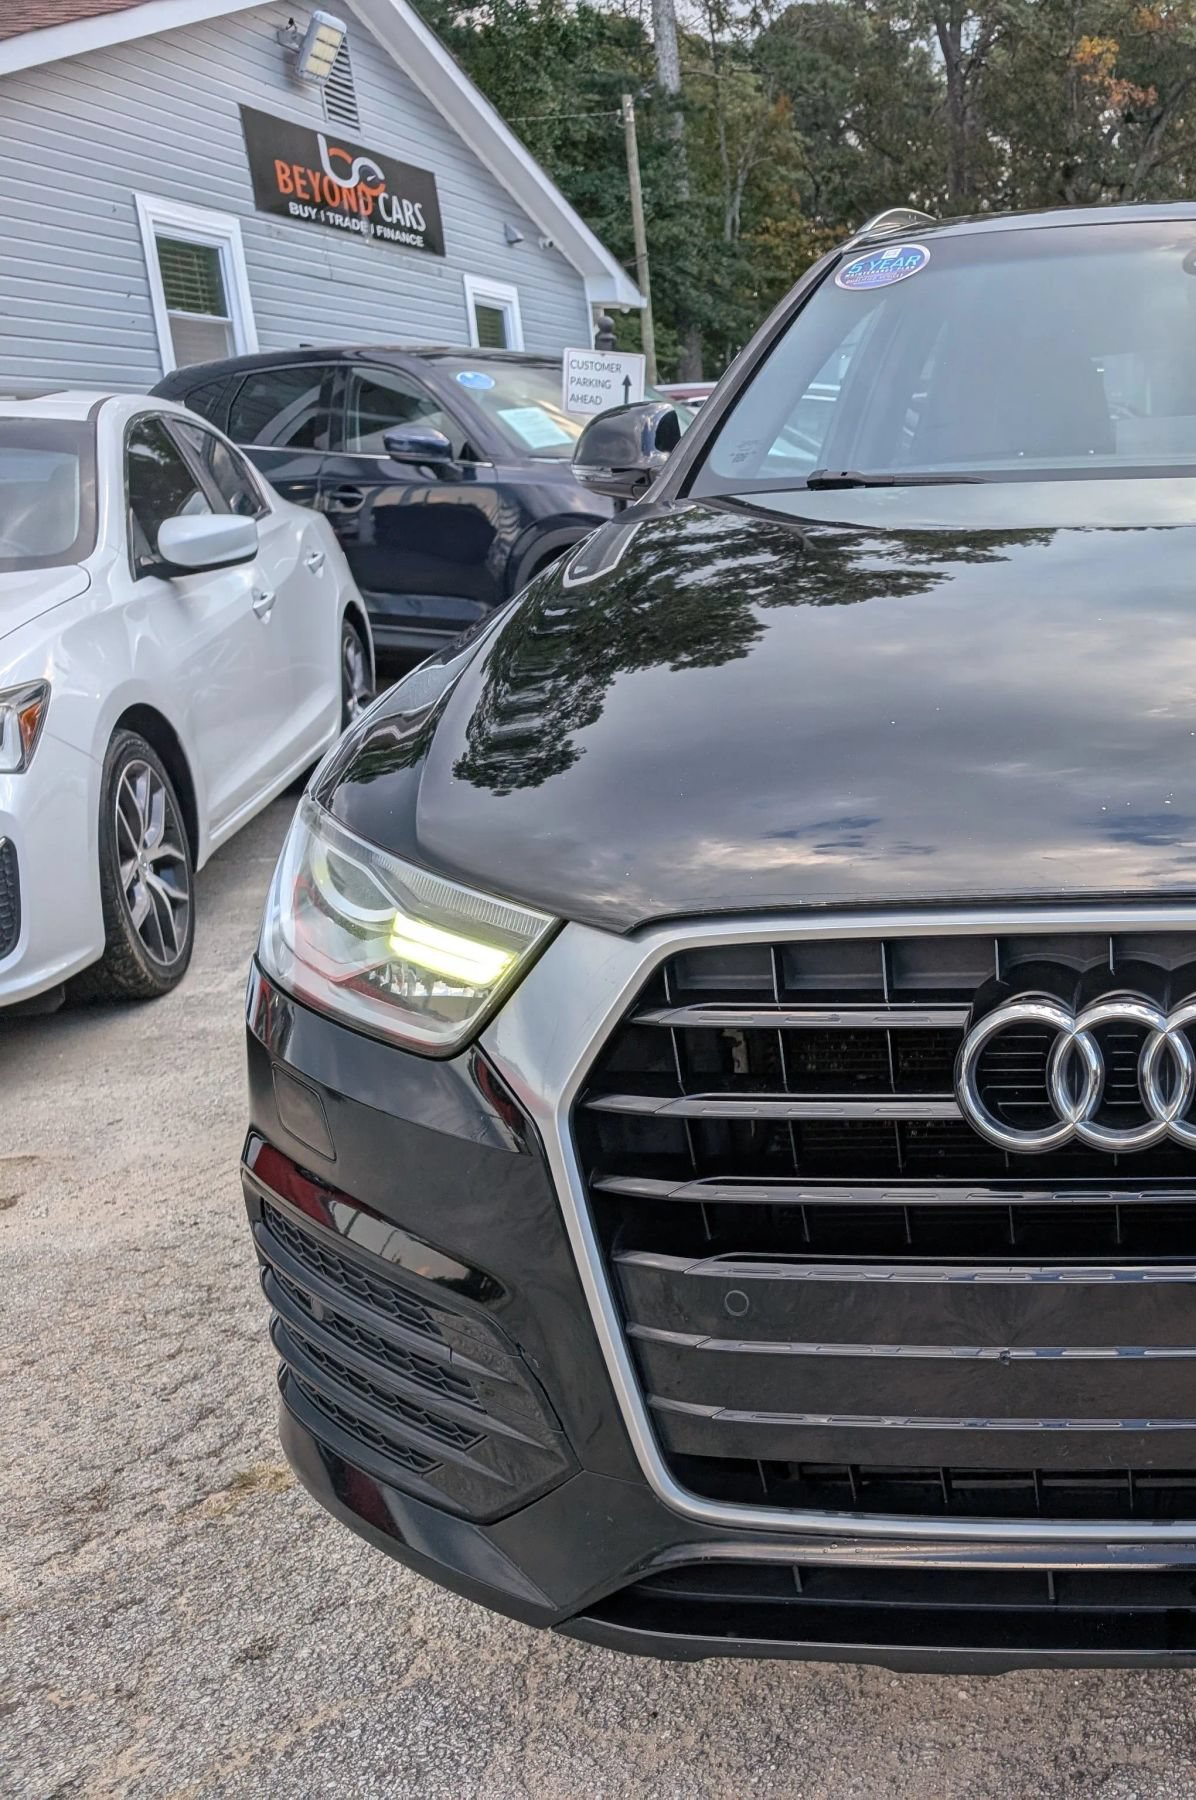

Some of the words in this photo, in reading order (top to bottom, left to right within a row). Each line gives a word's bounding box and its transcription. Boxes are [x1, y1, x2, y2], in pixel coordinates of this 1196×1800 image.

[274, 159, 374, 217] BEYOND
[377, 192, 427, 232] CARS
[288, 201, 318, 221] BUY
[326, 211, 368, 233] TRADE
[376, 225, 425, 248] FINANCE
[847, 262, 865, 274] 5
[869, 255, 921, 270] YEAR
[569, 359, 622, 374] CUSTOMER
[569, 376, 612, 390] PARKING
[569, 393, 603, 406] AHEAD
